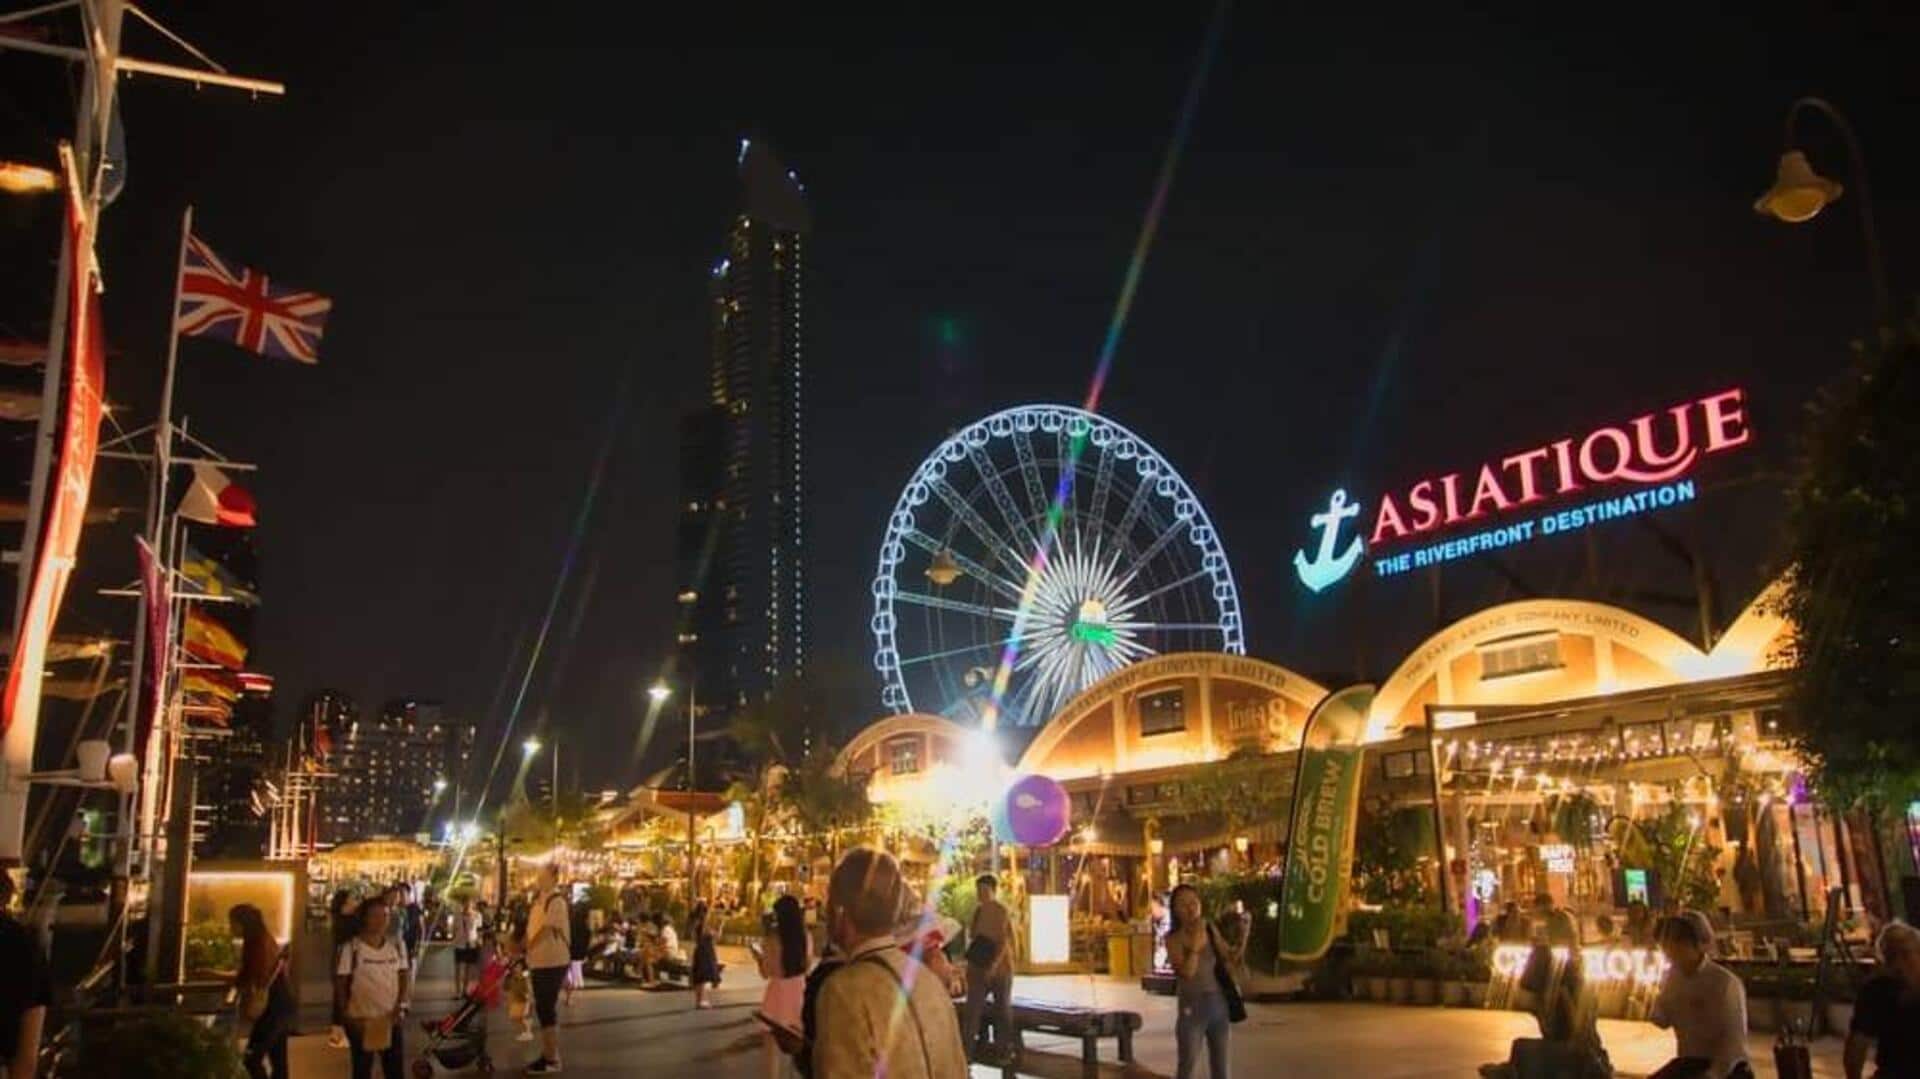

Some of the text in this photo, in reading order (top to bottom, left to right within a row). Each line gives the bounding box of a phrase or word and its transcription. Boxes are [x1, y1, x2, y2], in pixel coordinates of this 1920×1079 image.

[1369, 388, 1750, 544] ASIATIQUE
[1375, 480, 1696, 577] THE RIVERFRONT DESTINATION
[1585, 612, 1640, 640] LIMITED
[1307, 758, 1341, 904] COLD BREW
